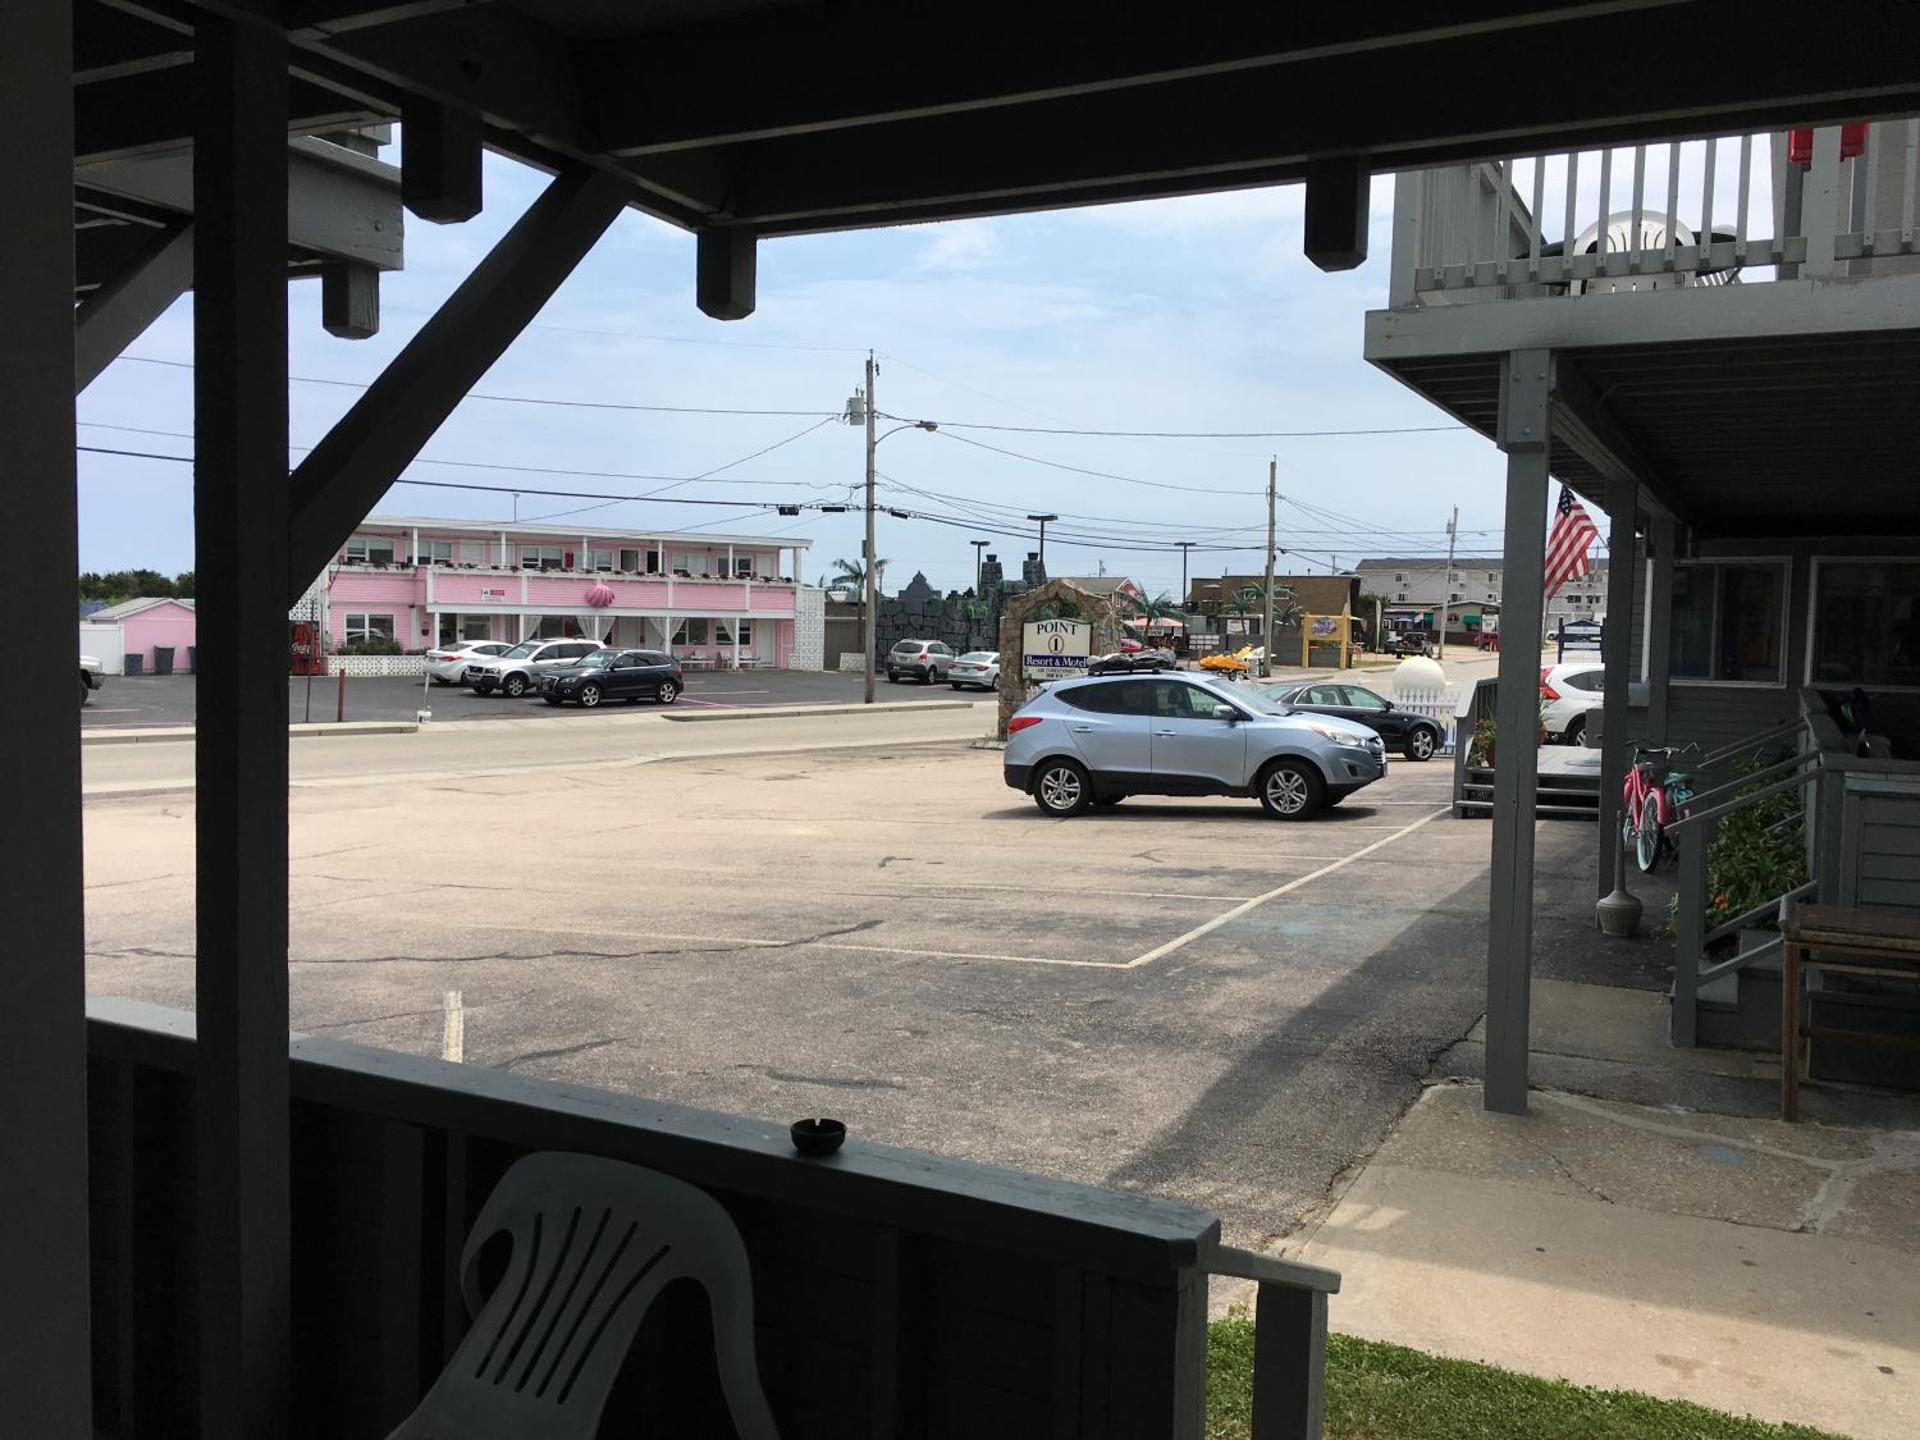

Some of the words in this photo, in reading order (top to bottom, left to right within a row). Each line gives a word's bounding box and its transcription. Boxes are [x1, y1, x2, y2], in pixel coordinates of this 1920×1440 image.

[1037, 622, 1079, 635] POINT
[1026, 656, 1053, 666] Resort
[1054, 658, 1061, 666] &
[1062, 657, 1087, 667] Motel
